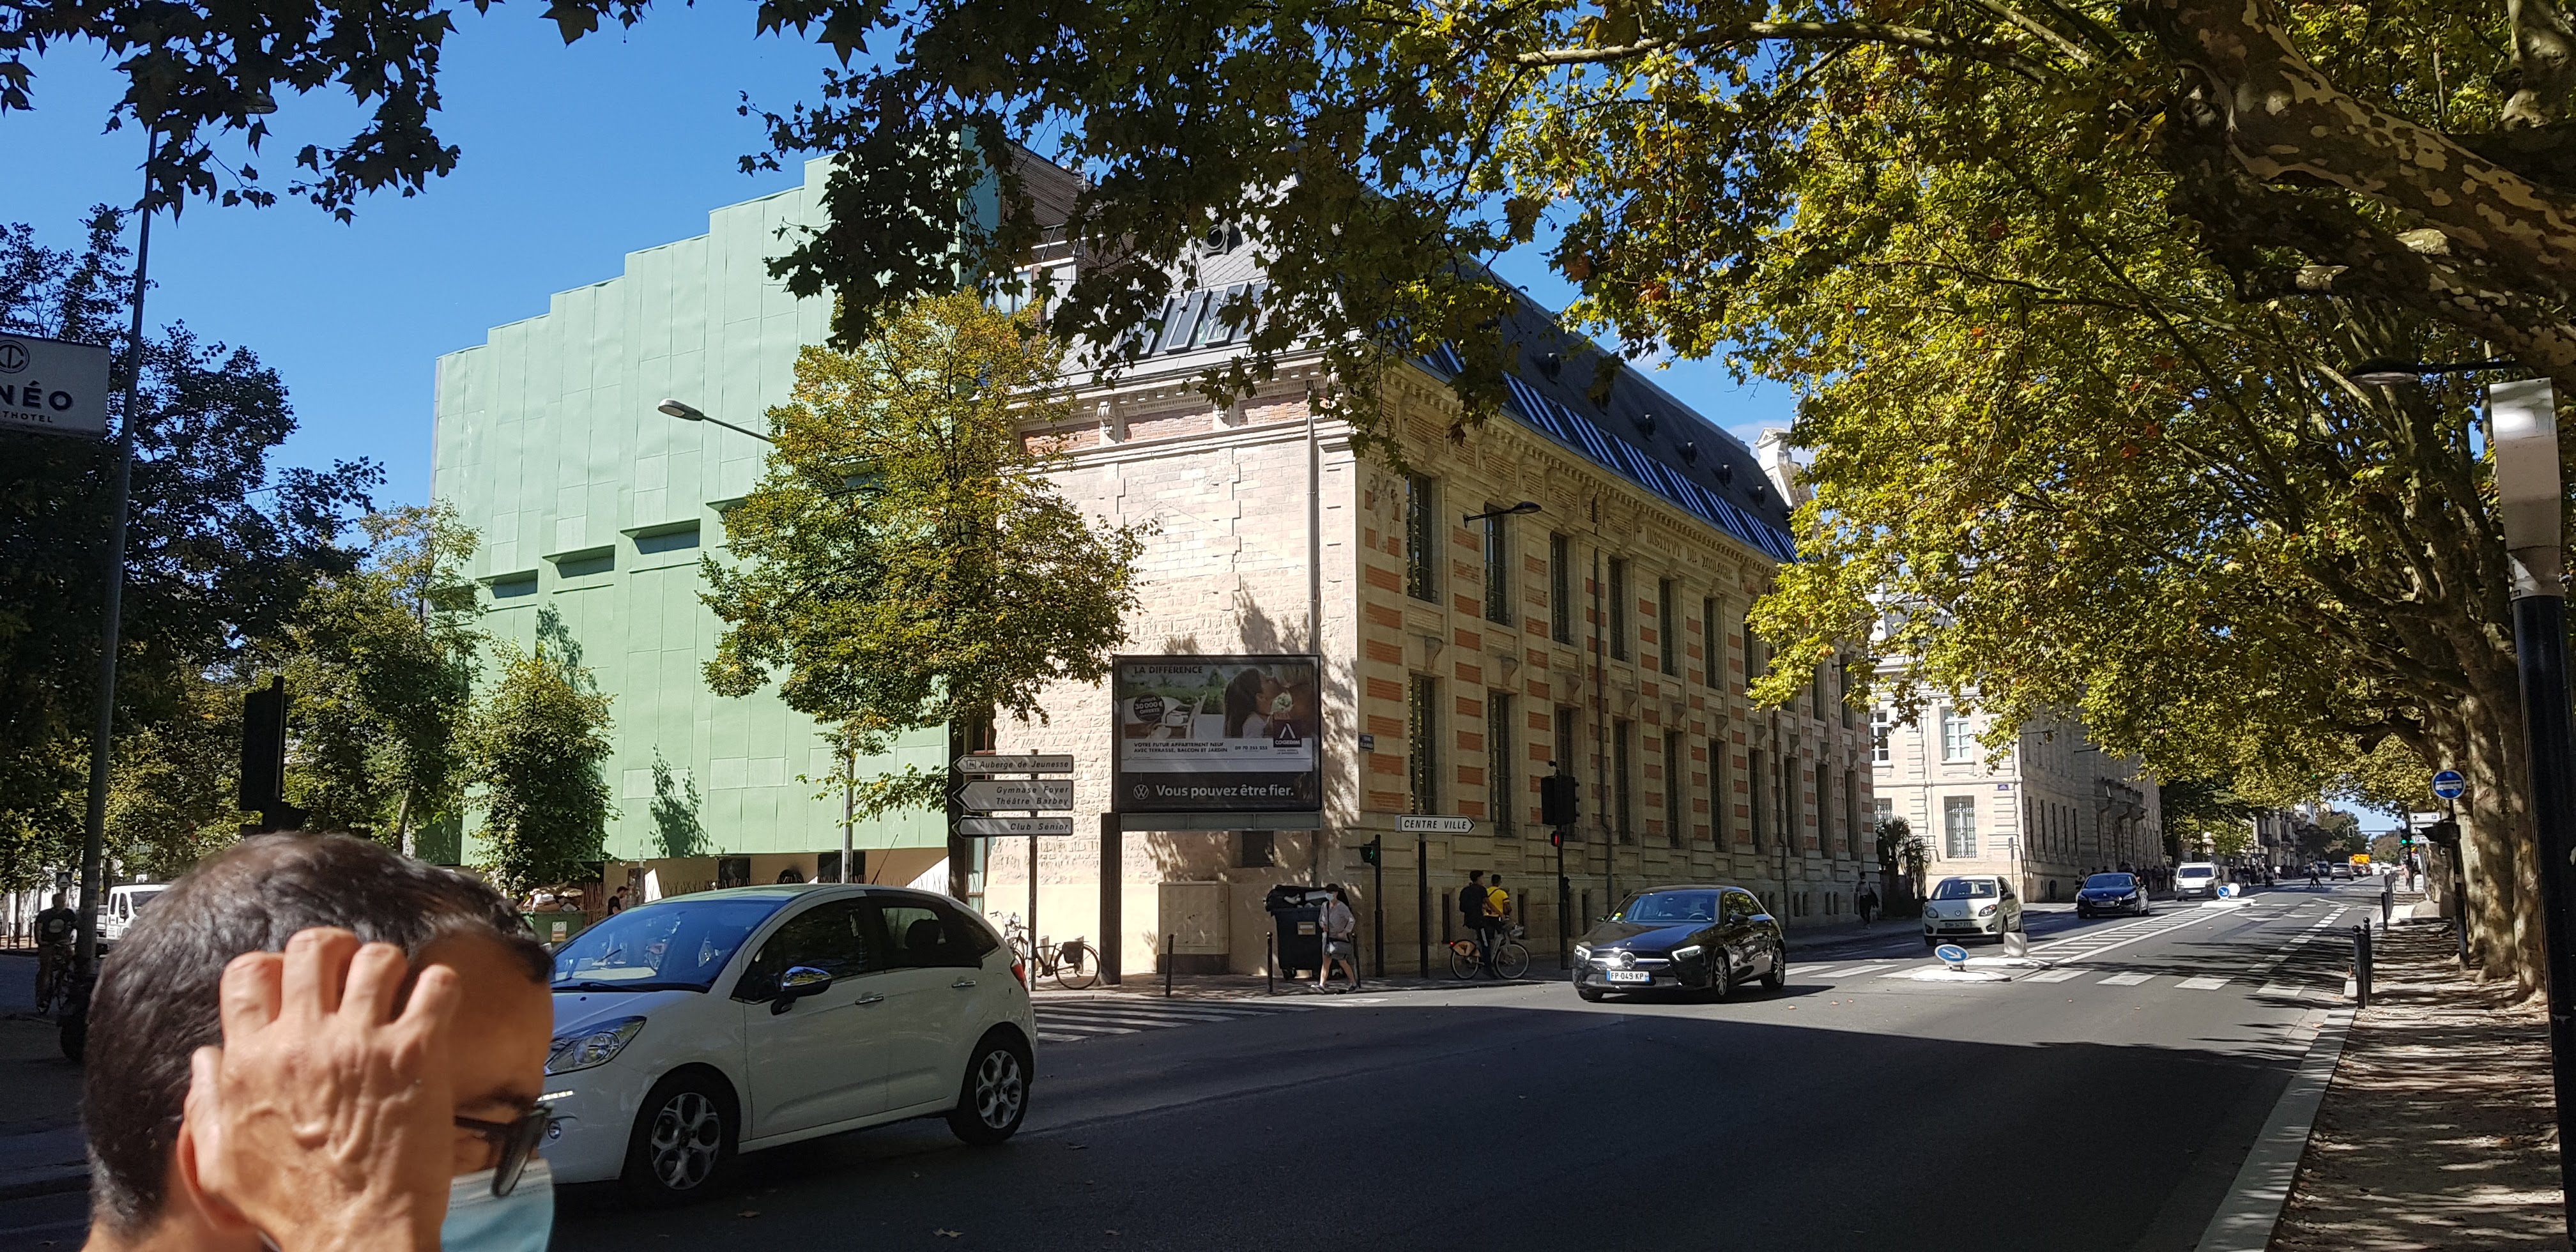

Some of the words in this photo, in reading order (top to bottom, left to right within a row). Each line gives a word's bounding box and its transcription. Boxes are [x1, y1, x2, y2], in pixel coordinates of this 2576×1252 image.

[1686, 546, 1698, 563] DE
[979, 760, 1013, 770] Auberge
[997, 786, 1037, 795] Gymnase
[1043, 786, 1069, 795] Foyer
[1156, 784, 1188, 797] Vous
[1191, 787, 1238, 799] pouvez
[1240, 784, 1267, 797] être
[1269, 784, 1294, 797] fier.
[1036, 797, 1069, 806] Barbey
[1404, 820, 1438, 828] CENTRE
[1444, 820, 1467, 829] VILLE
